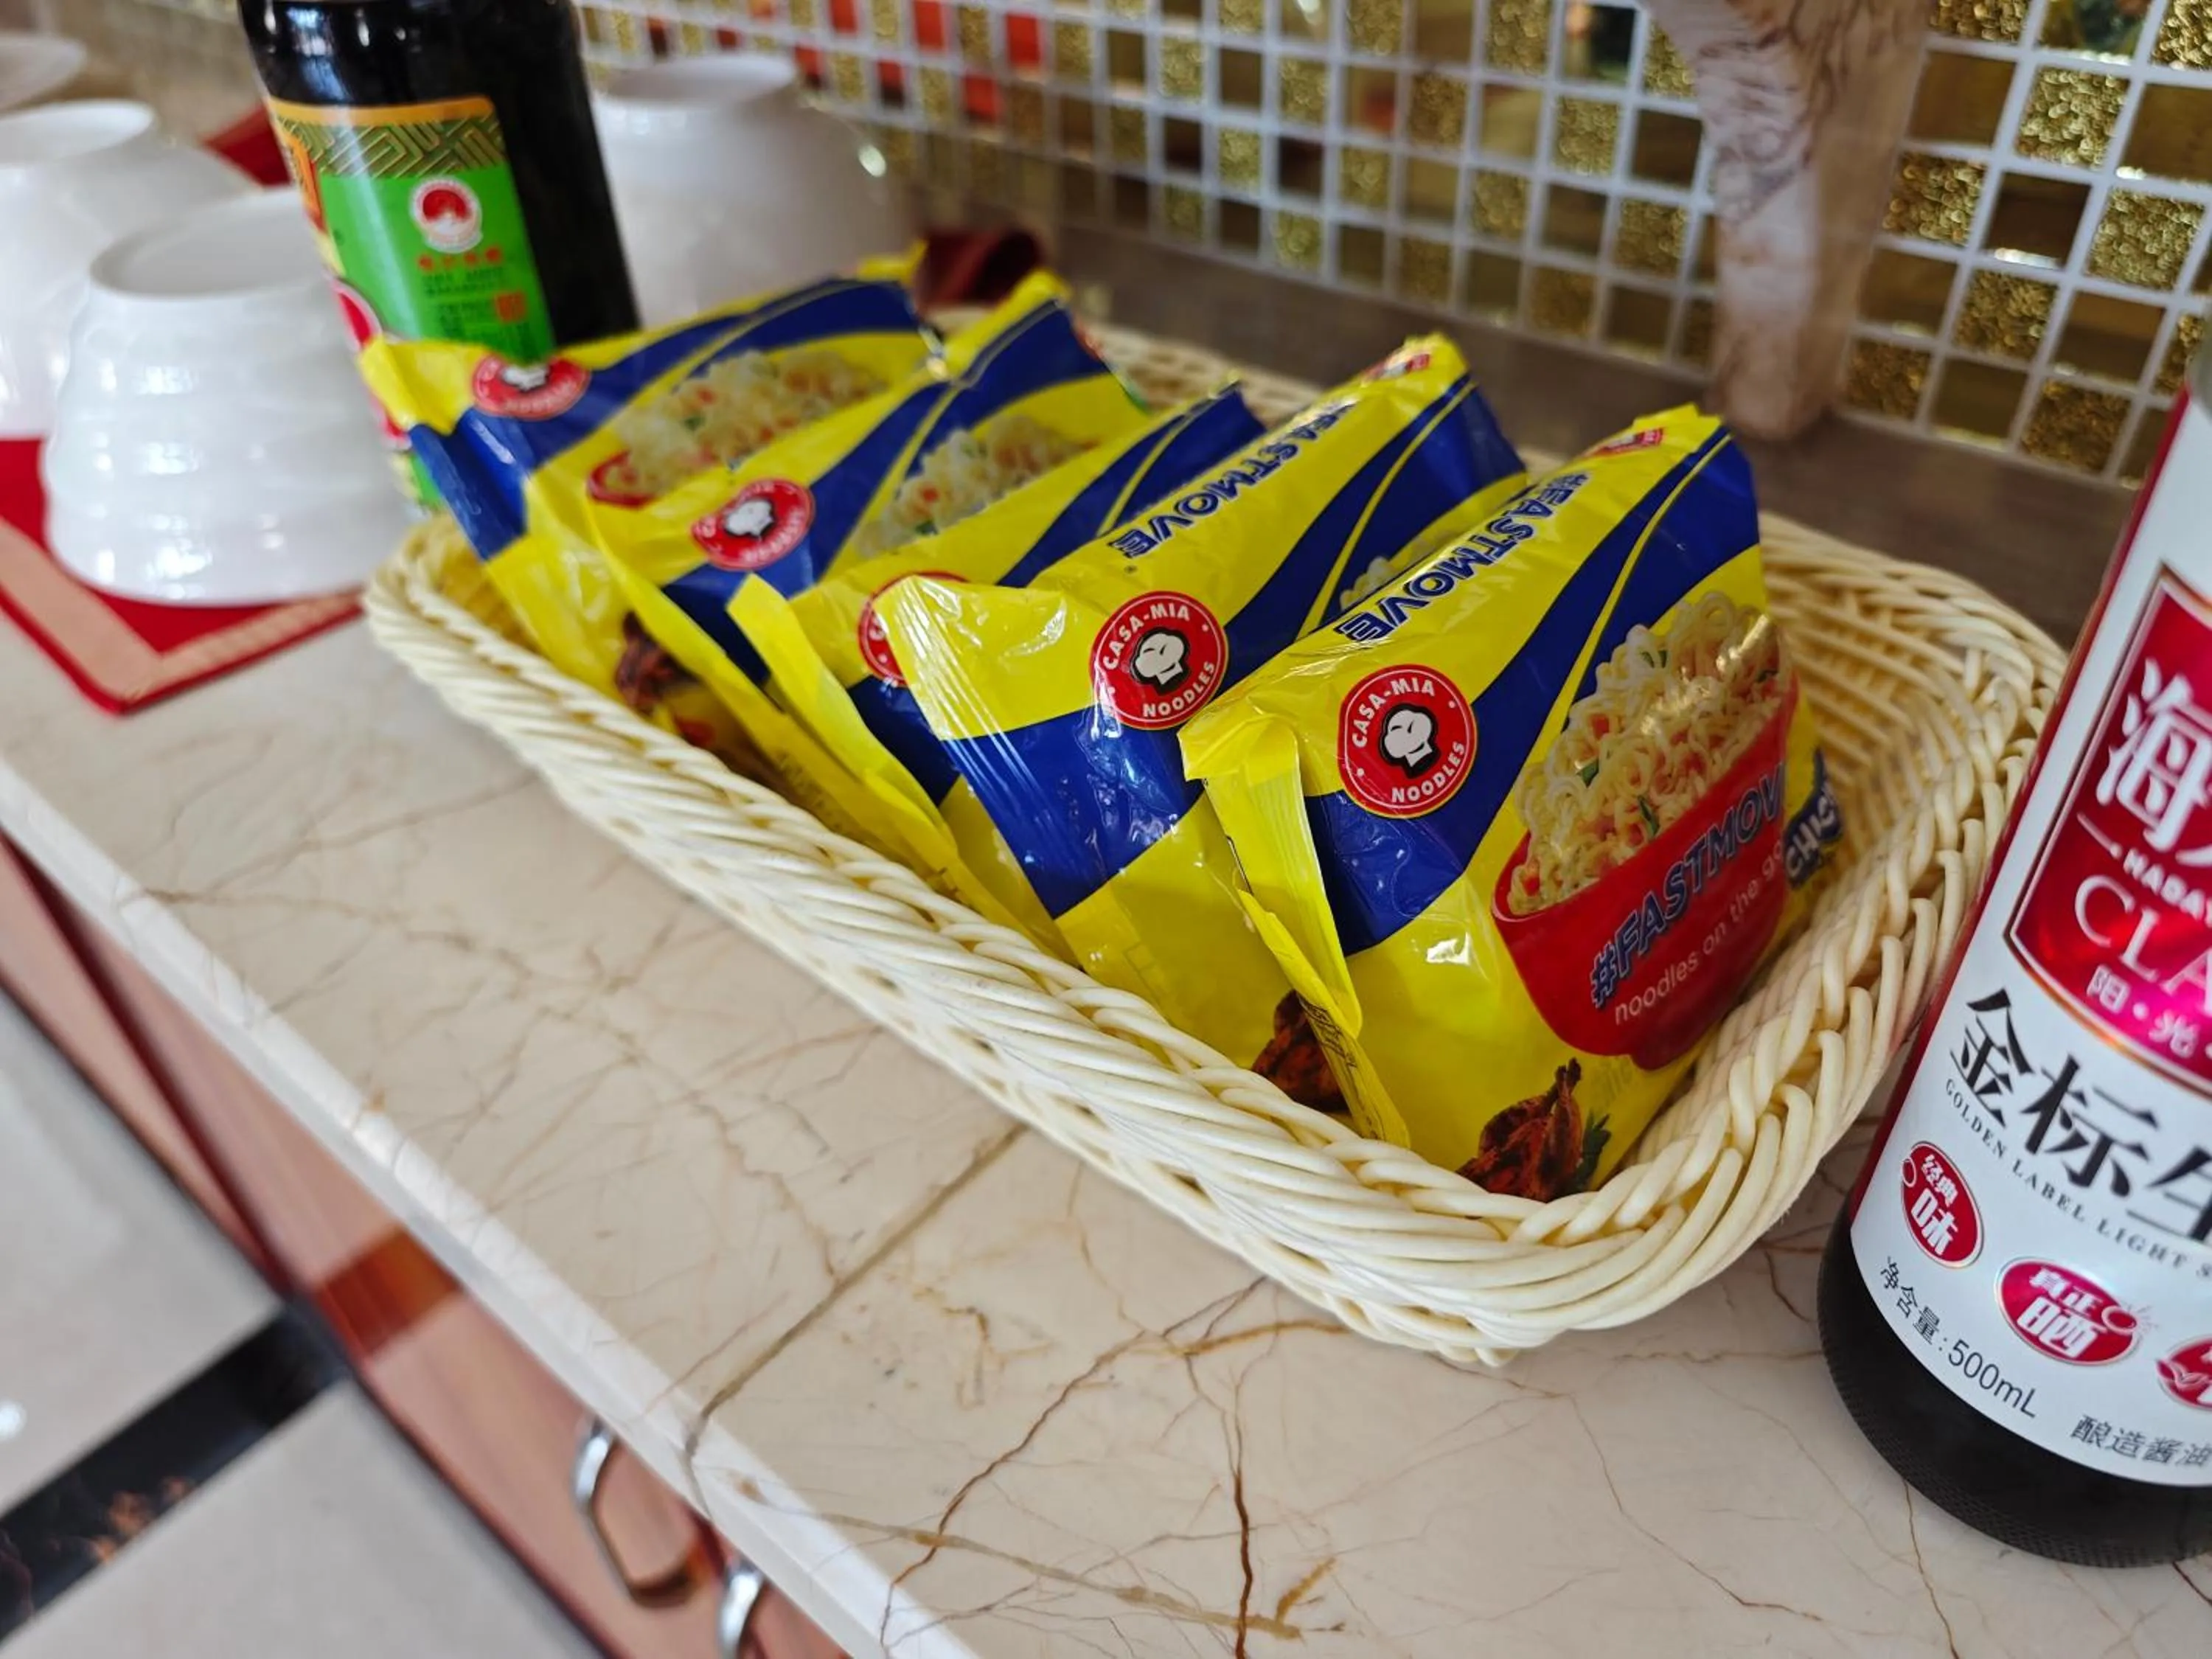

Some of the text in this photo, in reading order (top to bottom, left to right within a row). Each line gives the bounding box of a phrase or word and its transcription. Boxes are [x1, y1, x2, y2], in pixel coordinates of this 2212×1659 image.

[1334, 472, 1590, 642] #FASTMOVE
[1102, 602, 1191, 670] CASA-MIA
[1142, 661, 1215, 718] NOODLES
[1352, 677, 1436, 748] CASA-MIA
[1391, 741, 1465, 803] NOODLES
[1614, 956, 1698, 1026] noodles
[1703, 920, 1728, 956] on
[1728, 883, 1759, 922] the
[1921, 1153, 1958, 1208] 经典
[1945, 1079, 2008, 1159] GOLDEN
[2011, 1158, 2085, 1222] LABEL
[2096, 1217, 2188, 1268] LIGHT
[1910, 1187, 1959, 1256] 味
